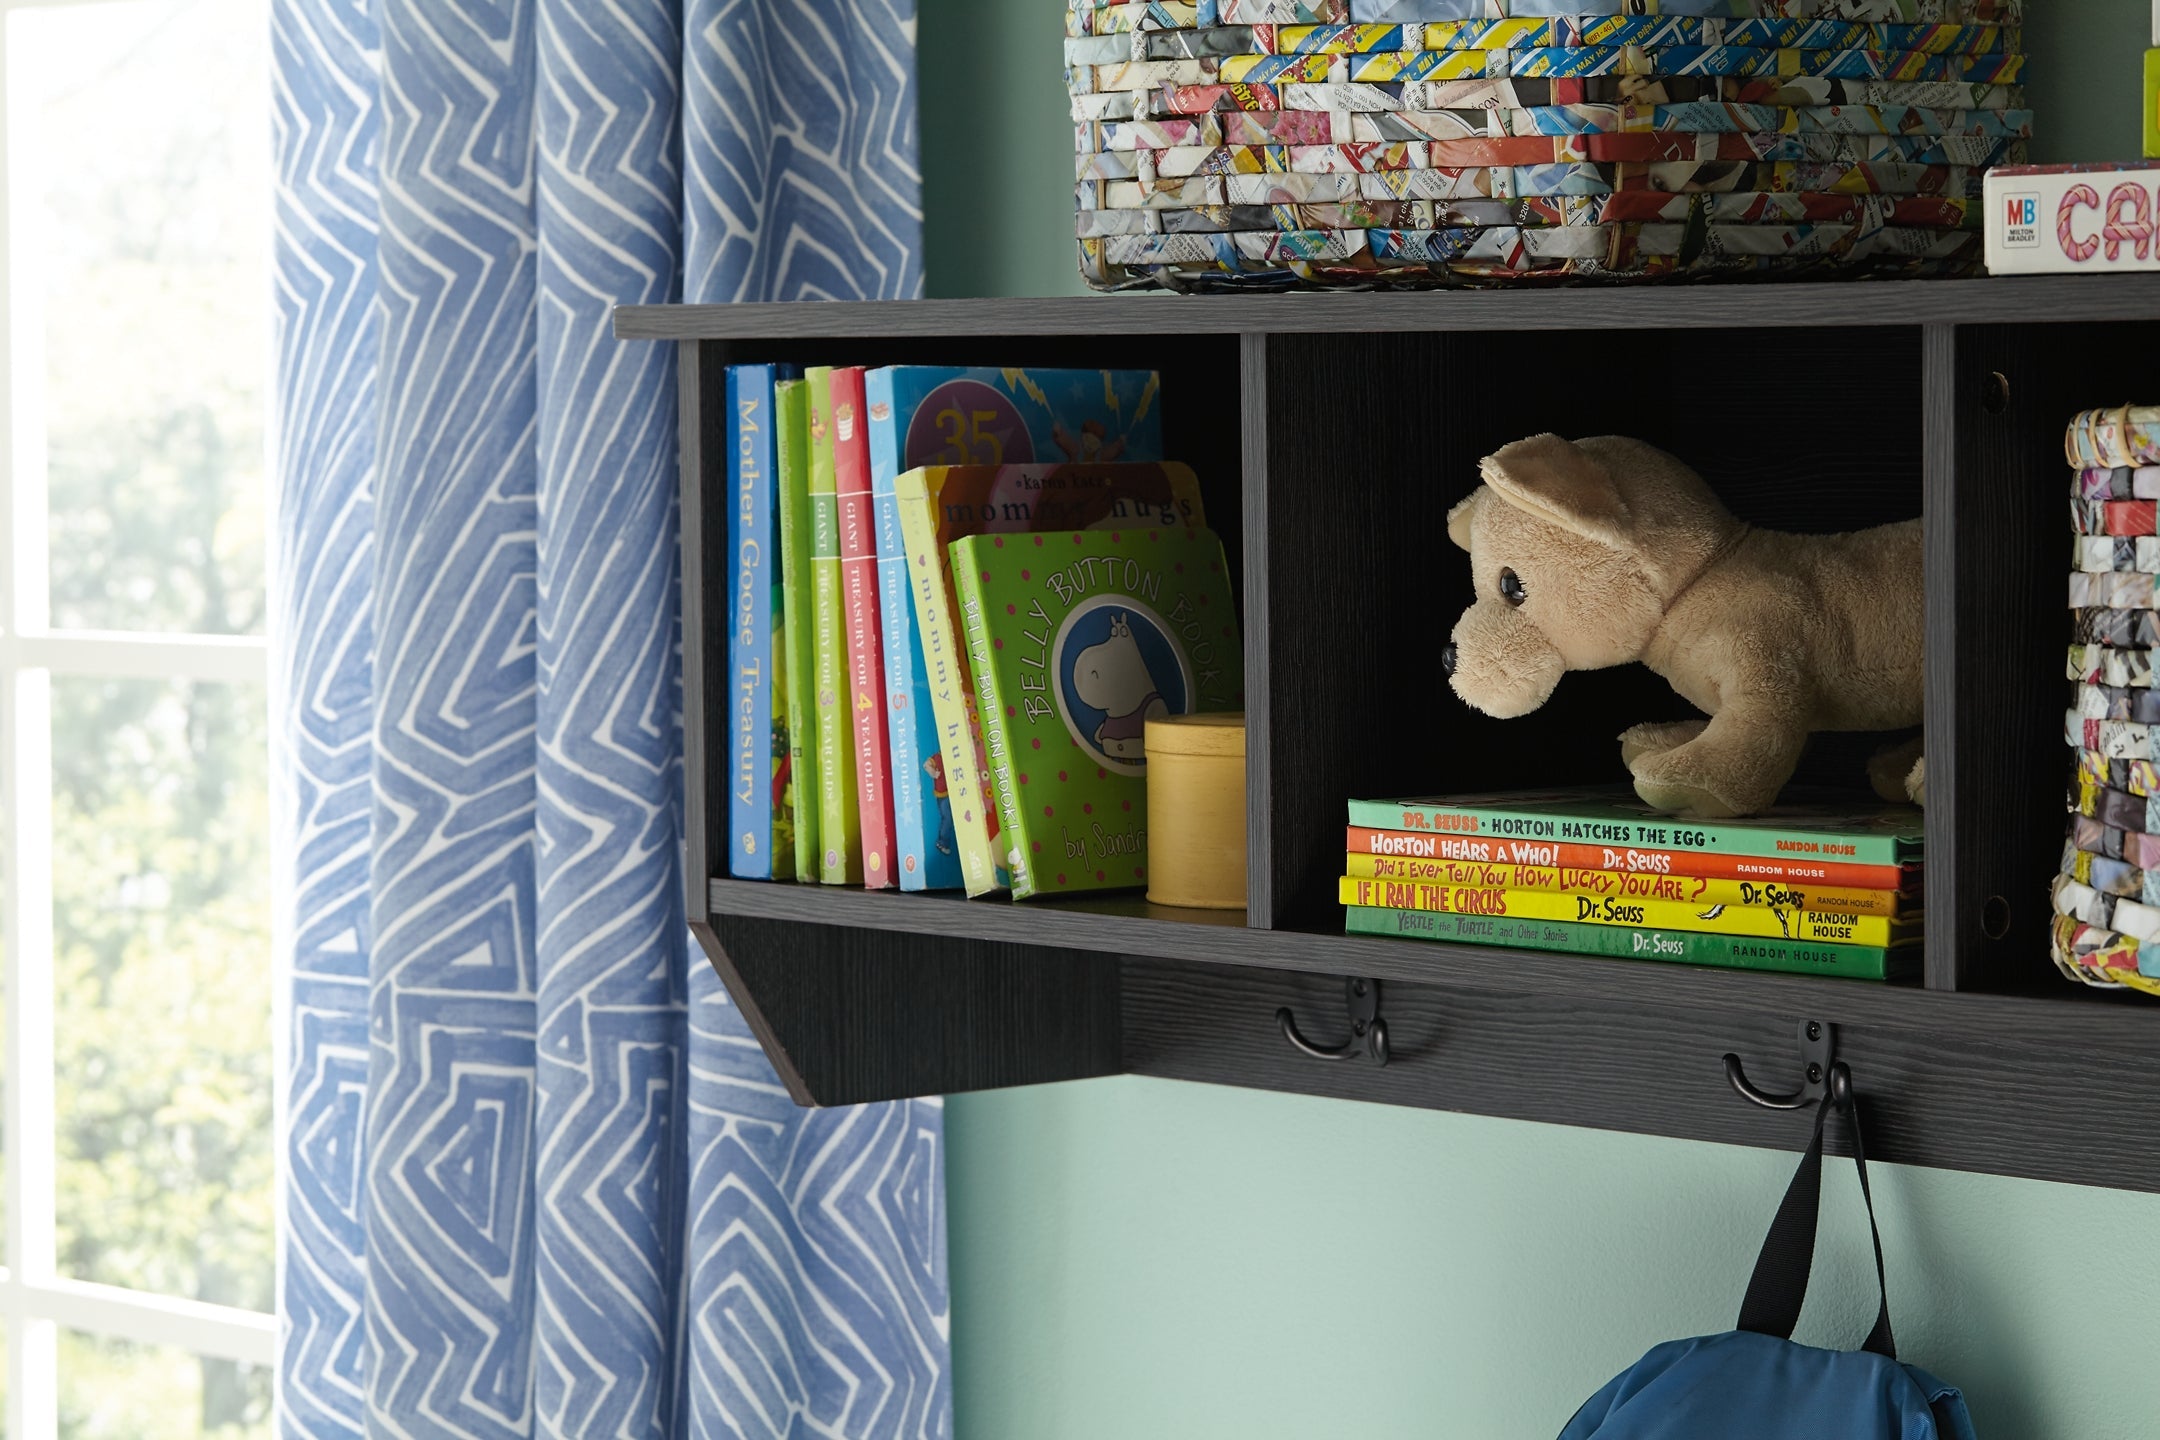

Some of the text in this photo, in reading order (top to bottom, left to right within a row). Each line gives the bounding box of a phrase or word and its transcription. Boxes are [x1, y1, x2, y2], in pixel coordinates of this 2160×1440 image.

[2007, 199, 2036, 226] MB
[2007, 235, 2036, 243] BRADLEY
[2009, 228, 2035, 236] MILTON
[2056, 181, 2160, 263] CA
[935, 408, 1003, 464] 35
[1110, 495, 1193, 525] hugs
[736, 397, 761, 806] Mother Goose Treasury
[818, 501, 835, 801] GIANT TREASURY FOR 3 YEAR OLDS
[847, 501, 875, 803] GIANT TREASURY FOR 4 YEAR OLDS
[882, 502, 911, 804] GIANT TREASURY FOR 5 YEAR OLDS
[1020, 597, 1055, 726] BELLY
[1046, 556, 1163, 607] BUTTON
[921, 576, 967, 798] mommy hugs
[962, 596, 1019, 831] BELLY BUTTON BOOK!
[1062, 822, 1146, 872] by Sandr
[1371, 833, 1825, 878] HORTON HEARS A WHO! Dr. Seuss RANDOM HOUSE
[1402, 811, 1856, 856] DR. SEUSS HORTON HATCHES THE EGG RANDOM HOUSE
[1357, 880, 1859, 926] IF I RAN THE CIRCUS Dr. Seuss RANDOM
[1374, 858, 1395, 878] Did
[1397, 863, 1405, 878] I
[1409, 863, 1443, 880] Ever
[1446, 863, 1476, 883] Tell
[1477, 864, 1507, 886] You
[1739, 882, 1762, 905] Dr.
[1764, 884, 1806, 911] Seuss
[1816, 896, 1848, 907] RANDOM
[1849, 898, 1875, 909] HOUSE
[1397, 910, 1837, 964] YERTLE the TURTLE and Other Stories Dr. Seuss RANDOM HOUSE
[1812, 925, 1852, 939] HOUSE
